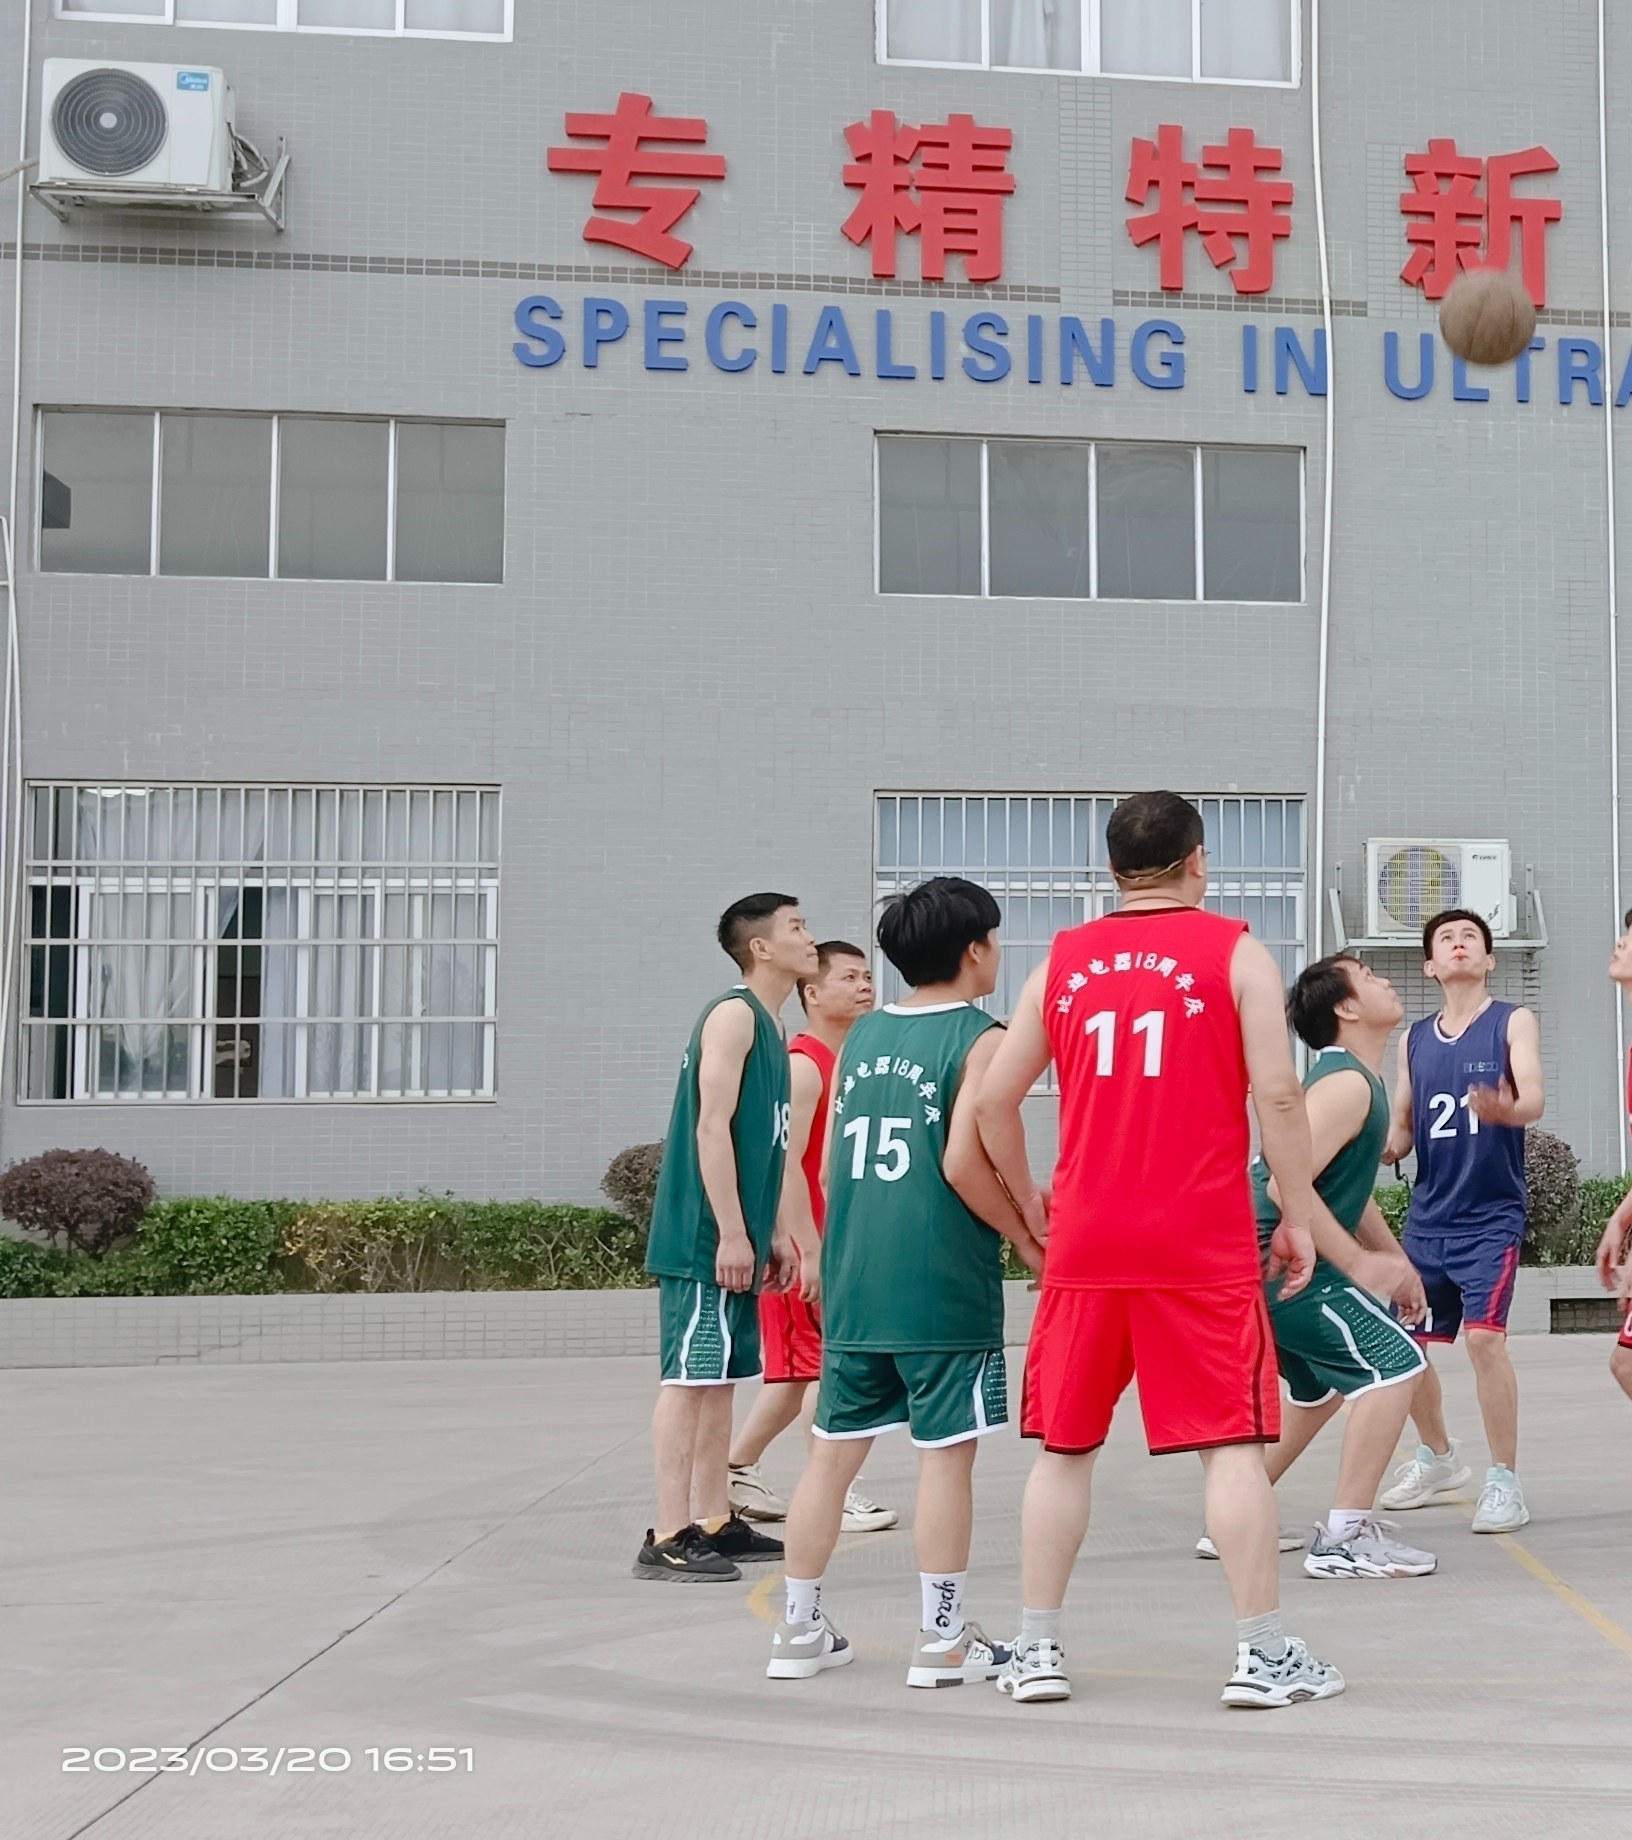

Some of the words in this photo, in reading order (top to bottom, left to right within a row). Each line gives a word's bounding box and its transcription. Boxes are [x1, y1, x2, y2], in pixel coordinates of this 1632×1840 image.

[514, 295, 1186, 391] SPECIALISING
[1243, 325, 1329, 397] IN
[1084, 1009, 1166, 1078] 11
[842, 1115, 913, 1183] 15
[1428, 1092, 1479, 1140] 21
